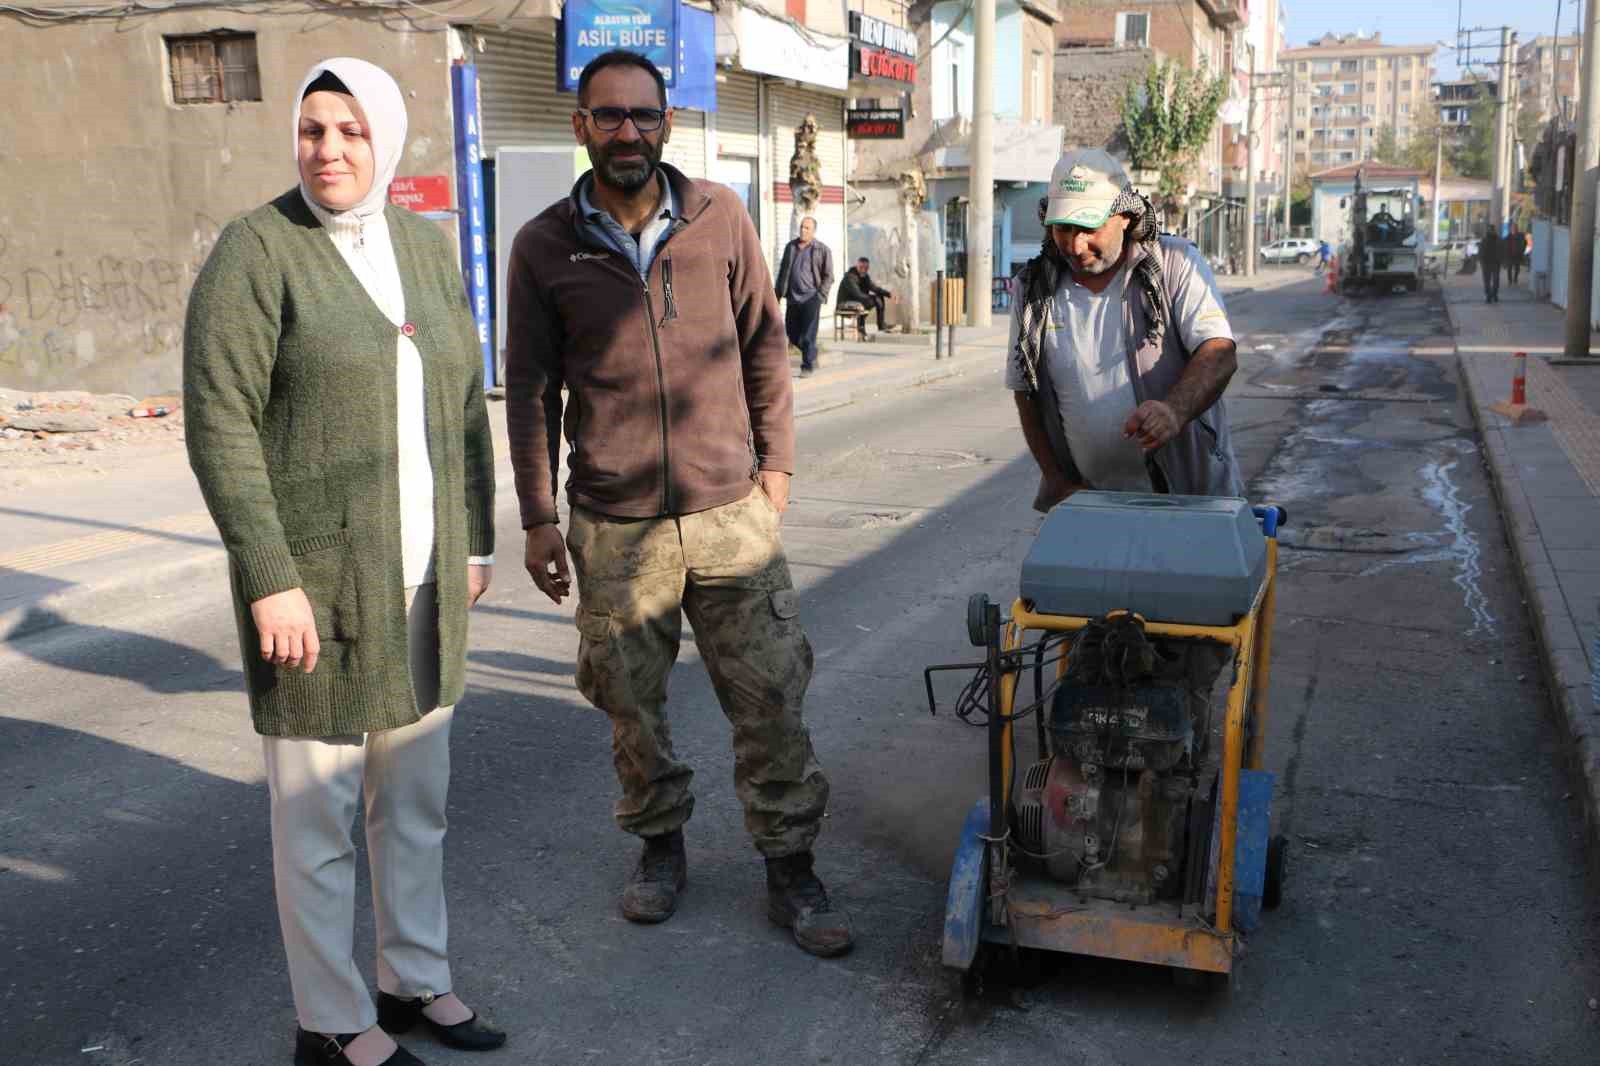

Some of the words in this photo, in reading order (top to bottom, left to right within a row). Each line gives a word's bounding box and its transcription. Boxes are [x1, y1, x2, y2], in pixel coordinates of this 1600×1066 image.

[577, 28, 616, 46] ASİL
[619, 26, 666, 46] BÜFE
[467, 114, 481, 226] ASİL
[473, 234, 488, 344] BÜFE
